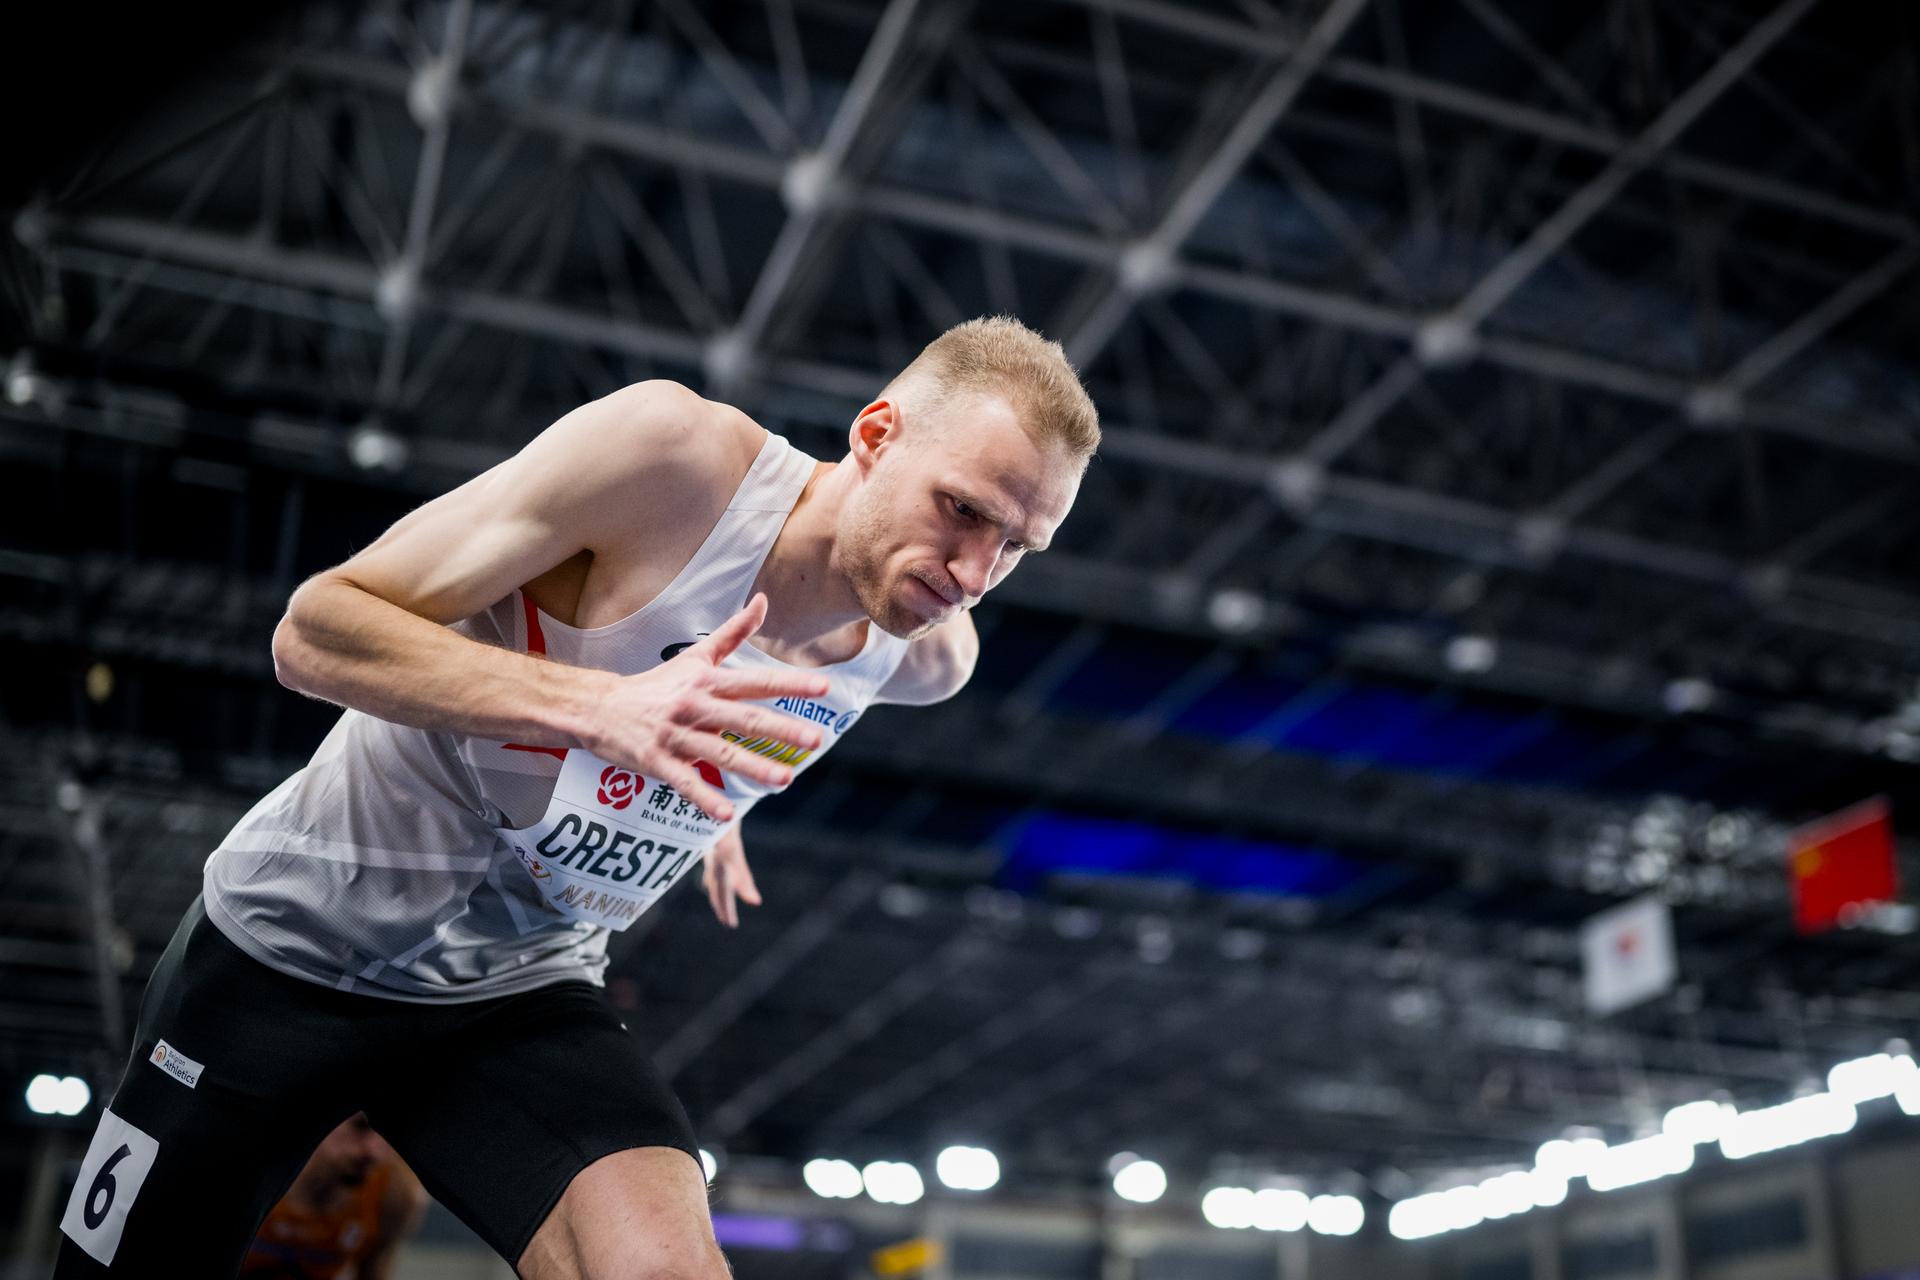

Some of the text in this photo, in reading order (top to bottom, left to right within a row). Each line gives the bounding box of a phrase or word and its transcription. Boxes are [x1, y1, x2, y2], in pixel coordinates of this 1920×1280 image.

[775, 695, 837, 726] Allianz
[641, 809, 670, 825] BANK
[670, 818, 683, 831] OF
[536, 813, 702, 890] CRESTA
[163, 1059, 195, 1085] Athletics
[167, 1050, 186, 1066] Belgian
[83, 1143, 132, 1231] 6
